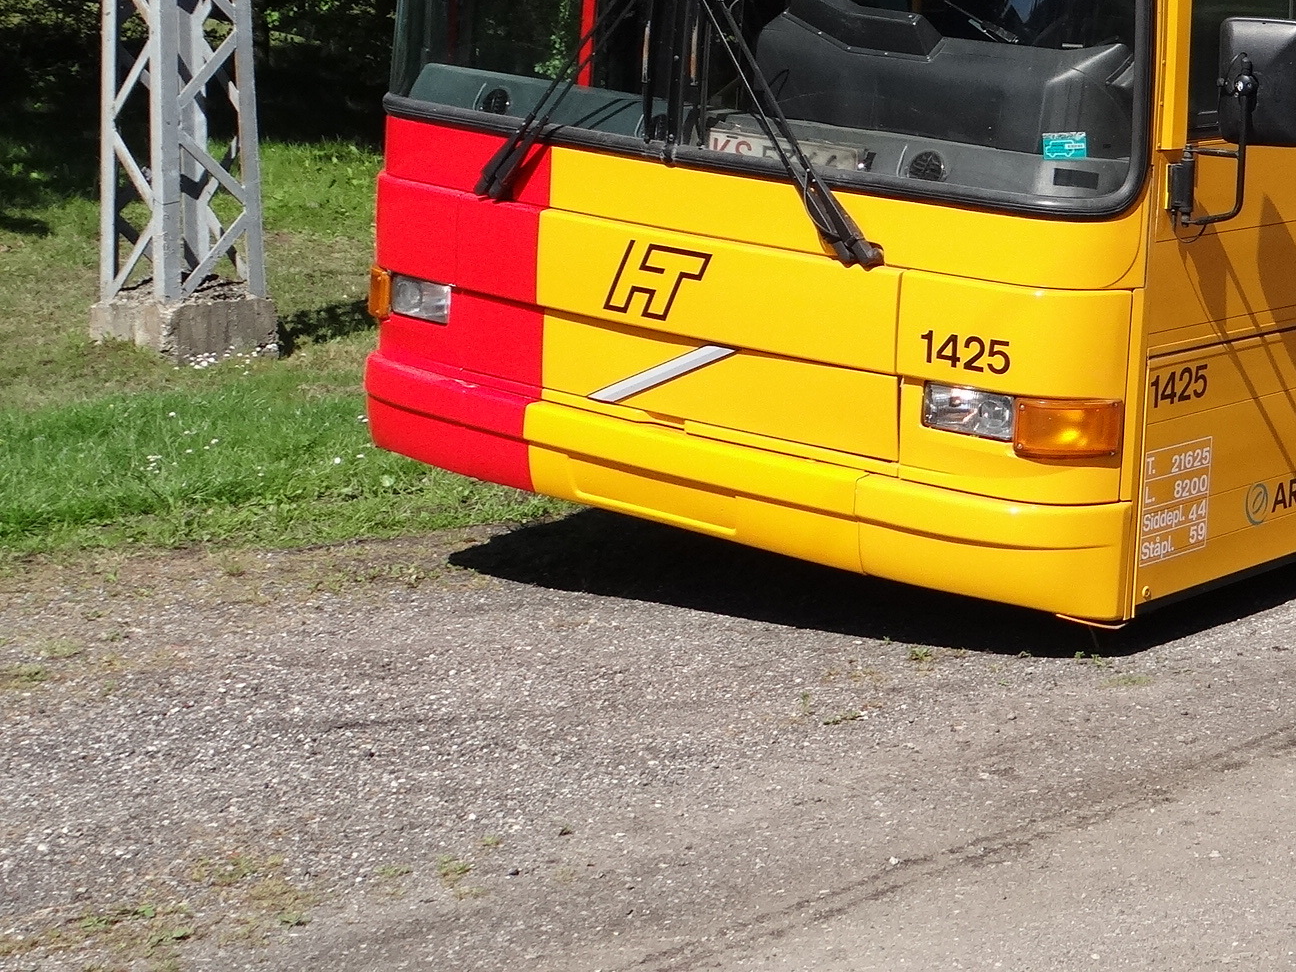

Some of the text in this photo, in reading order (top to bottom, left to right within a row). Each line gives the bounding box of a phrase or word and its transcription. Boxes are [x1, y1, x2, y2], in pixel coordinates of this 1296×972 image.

[920, 329, 1011, 375] 1425
[1150, 363, 1209, 409] 1425
[1146, 446, 1210, 475] T. 21625
[1144, 474, 1208, 504] L. 8200
[1143, 498, 1207, 533] Siddepl. 44
[1141, 522, 1206, 561] Ståpl. 59
